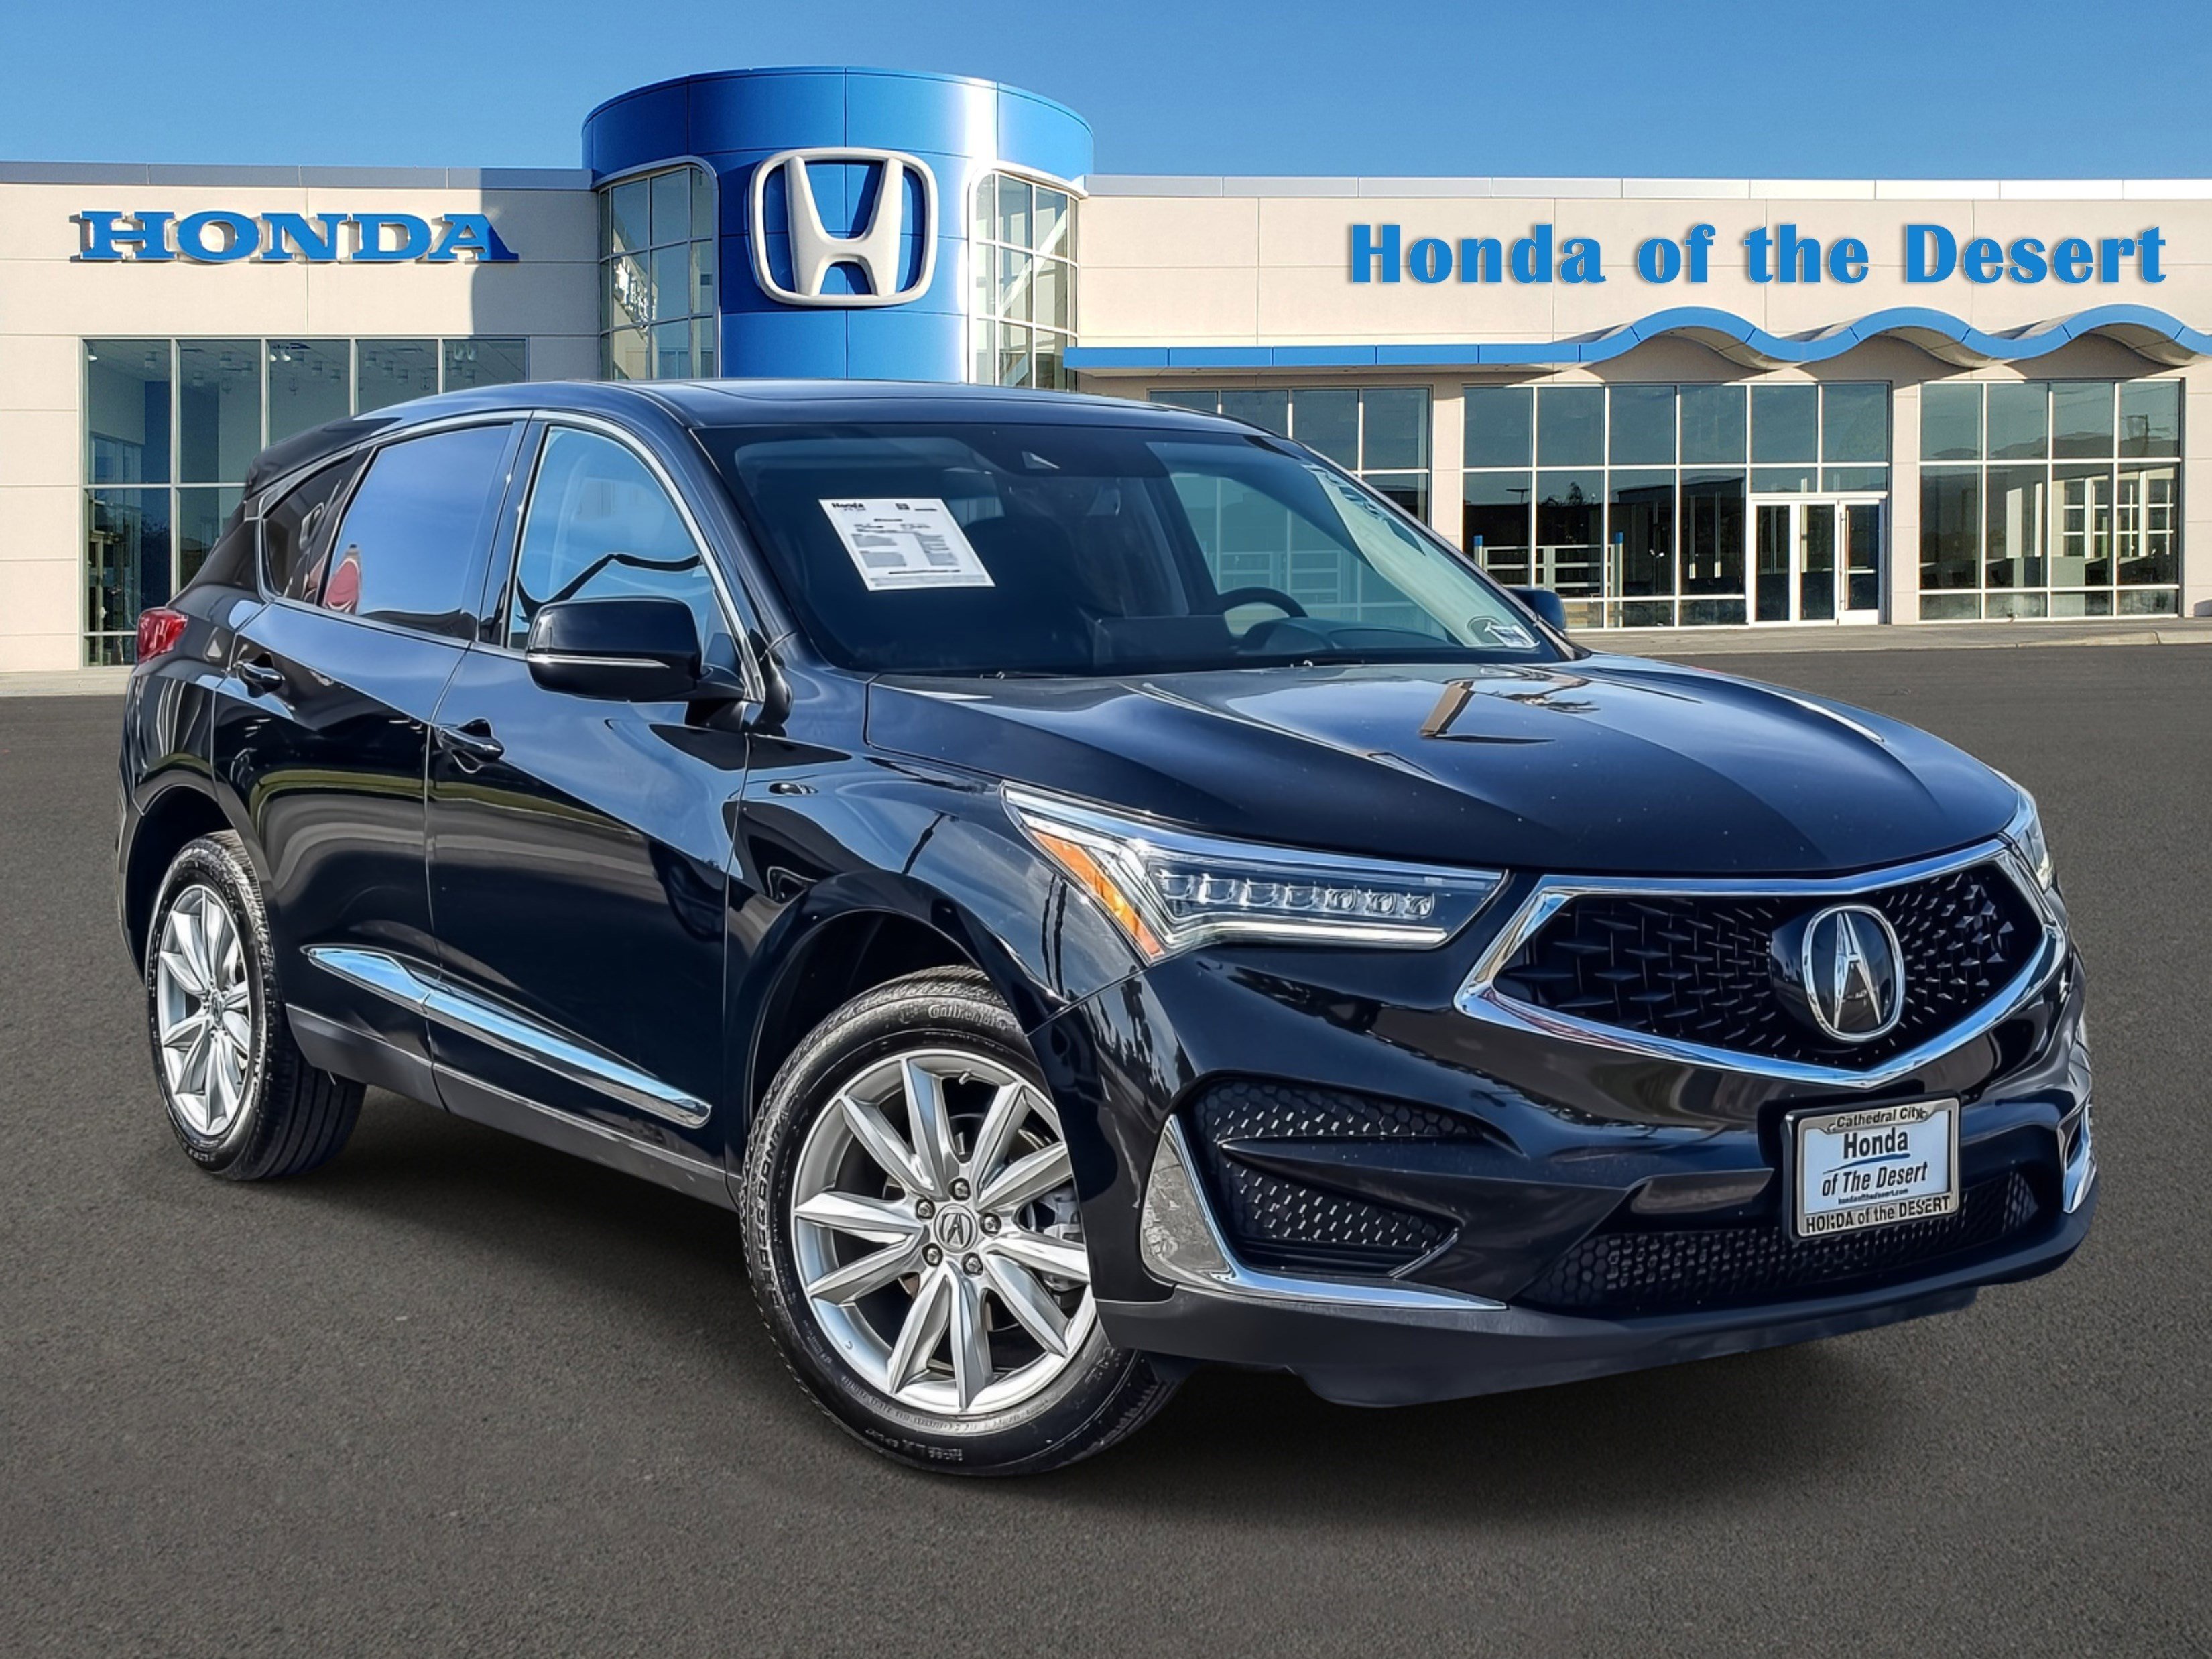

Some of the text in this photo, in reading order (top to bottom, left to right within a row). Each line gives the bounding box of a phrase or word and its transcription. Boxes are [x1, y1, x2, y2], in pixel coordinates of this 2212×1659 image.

[78, 210, 519, 262] HONDA
[1353, 224, 2165, 283] Honda of the Desert
[1836, 1106, 1924, 1128] Cathedral City
[1843, 1127, 1908, 1159] Honda
[1822, 1161, 1928, 1196] of The Desert
[1806, 1195, 1950, 1233] HONDA of the DESERT
